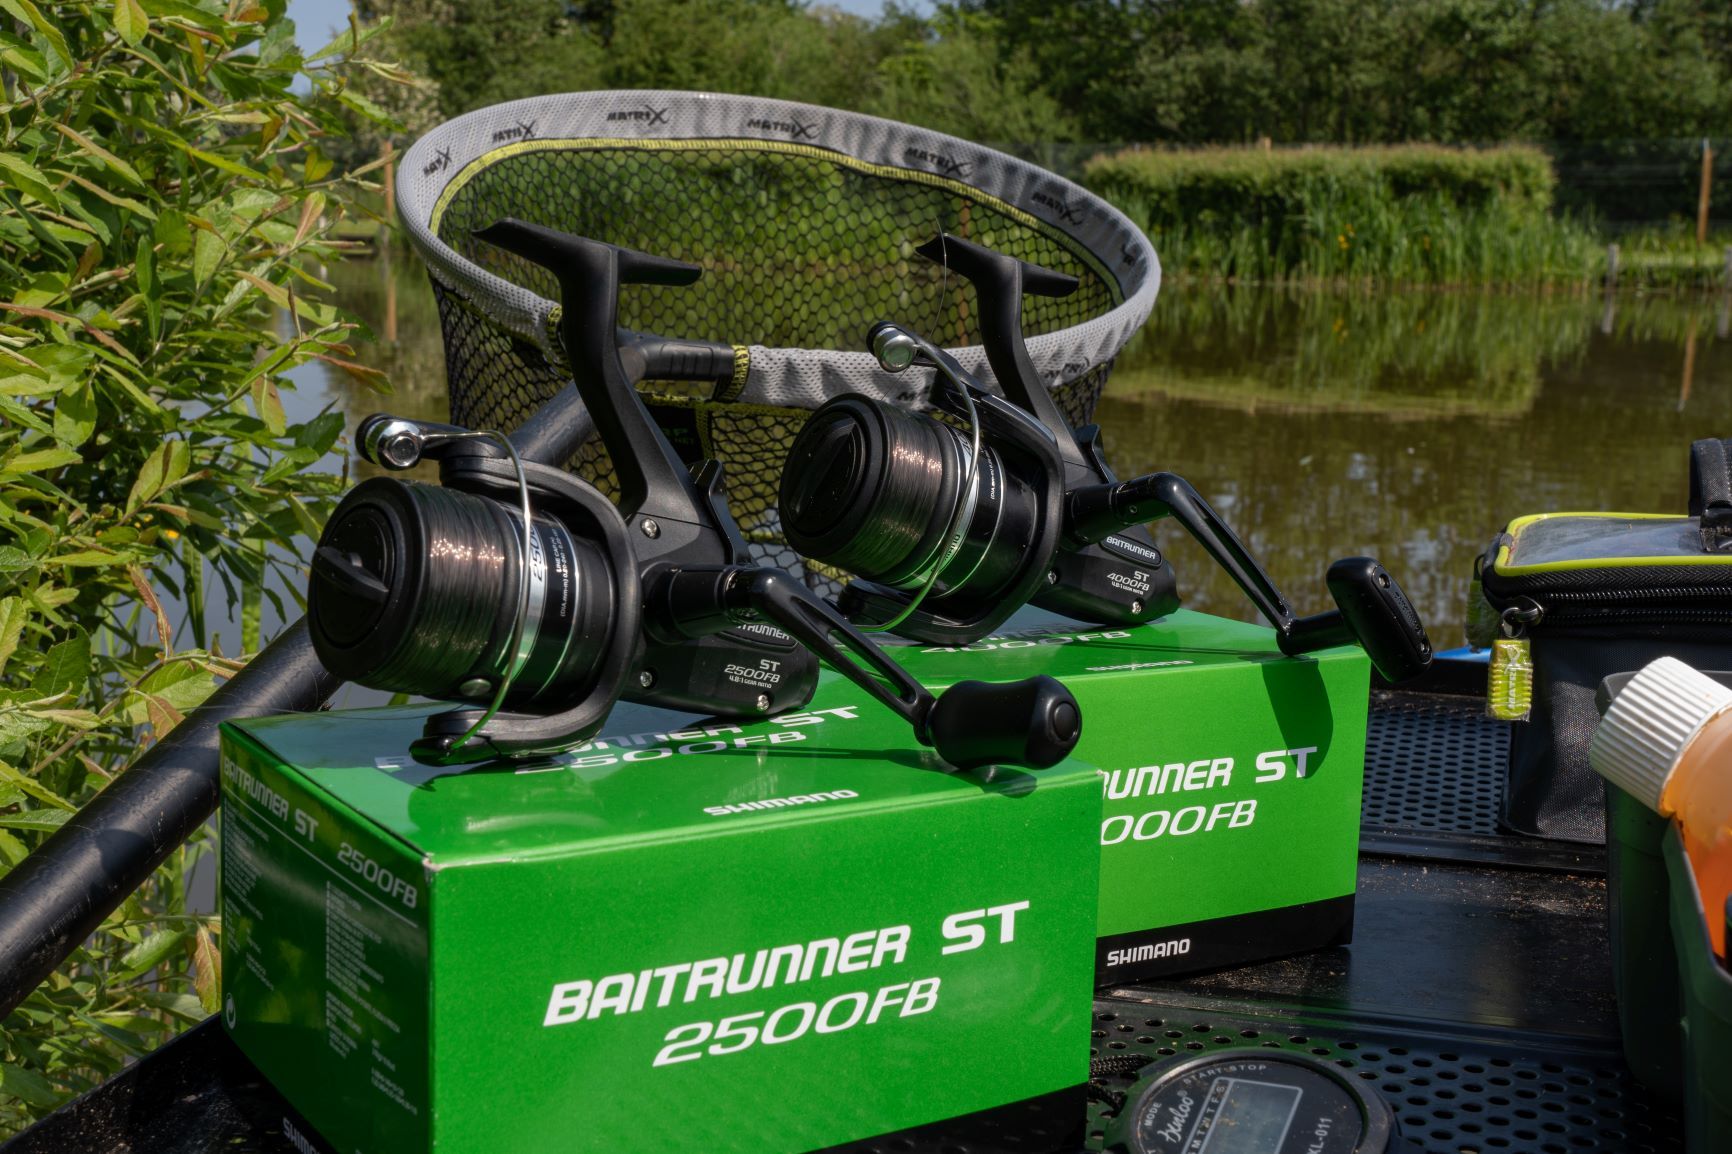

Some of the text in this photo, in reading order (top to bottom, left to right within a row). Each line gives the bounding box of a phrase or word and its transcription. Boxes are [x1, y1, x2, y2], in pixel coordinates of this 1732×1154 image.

[747, 115, 821, 140] MATRIX
[904, 147, 974, 178] MATRIX
[1106, 536, 1156, 559] BAITRUNNER
[1107, 573, 1150, 591] 4000FB
[1134, 571, 1150, 582] ST
[724, 664, 781, 683] 2500FB
[760, 659, 781, 671] ST
[772, 706, 860, 725] ST
[514, 731, 807, 775] 2500FB
[1255, 746, 1318, 784] ST
[703, 789, 859, 817] SHIMANO
[223, 758, 289, 822] BAITRUNNER
[294, 808, 319, 842] ST
[336, 841, 418, 909] 2500FB
[1100, 800, 1258, 846] 000FB
[542, 900, 1030, 1027] BAITRUNNER ST
[1106, 938, 1191, 967] SHIMANO
[652, 976, 942, 1067] 2500FB
[1144, 1102, 1162, 1127] MODE
